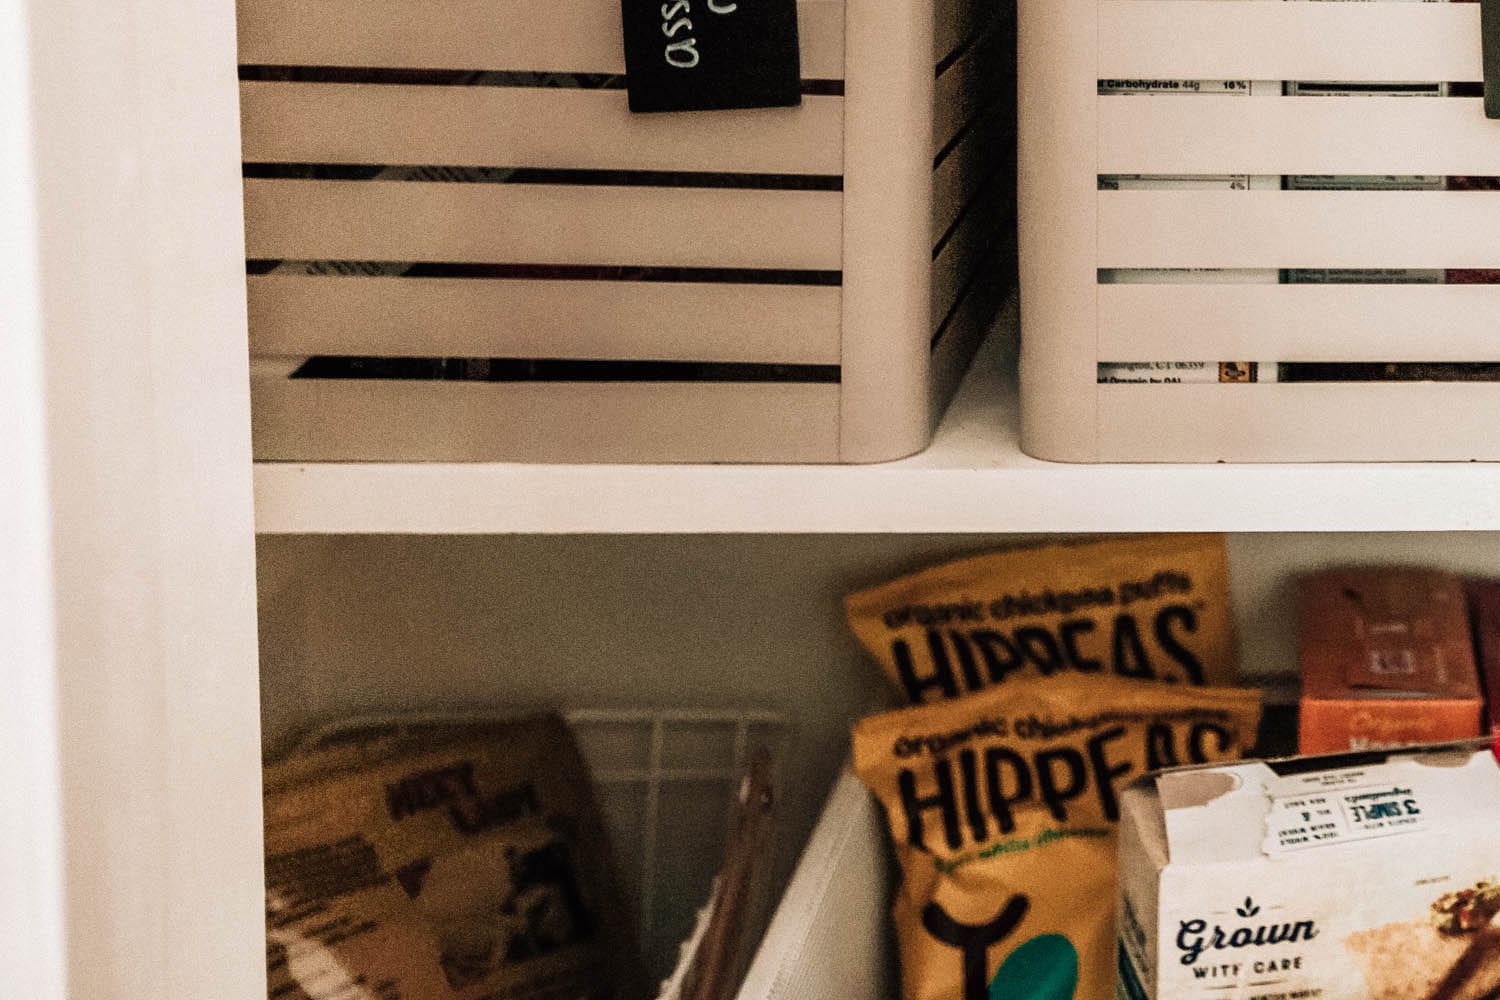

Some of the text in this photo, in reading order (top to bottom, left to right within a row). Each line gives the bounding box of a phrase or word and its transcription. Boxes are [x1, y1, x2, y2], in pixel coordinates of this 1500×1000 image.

[1107, 80, 1179, 91] Carbohydrate
[1182, 81, 1200, 90] 44g
[1350, 801, 1401, 823] SIMPLE
[1403, 799, 1421, 815] 3
[1176, 918, 1321, 966] Grown
[1253, 956, 1303, 975] CARE
